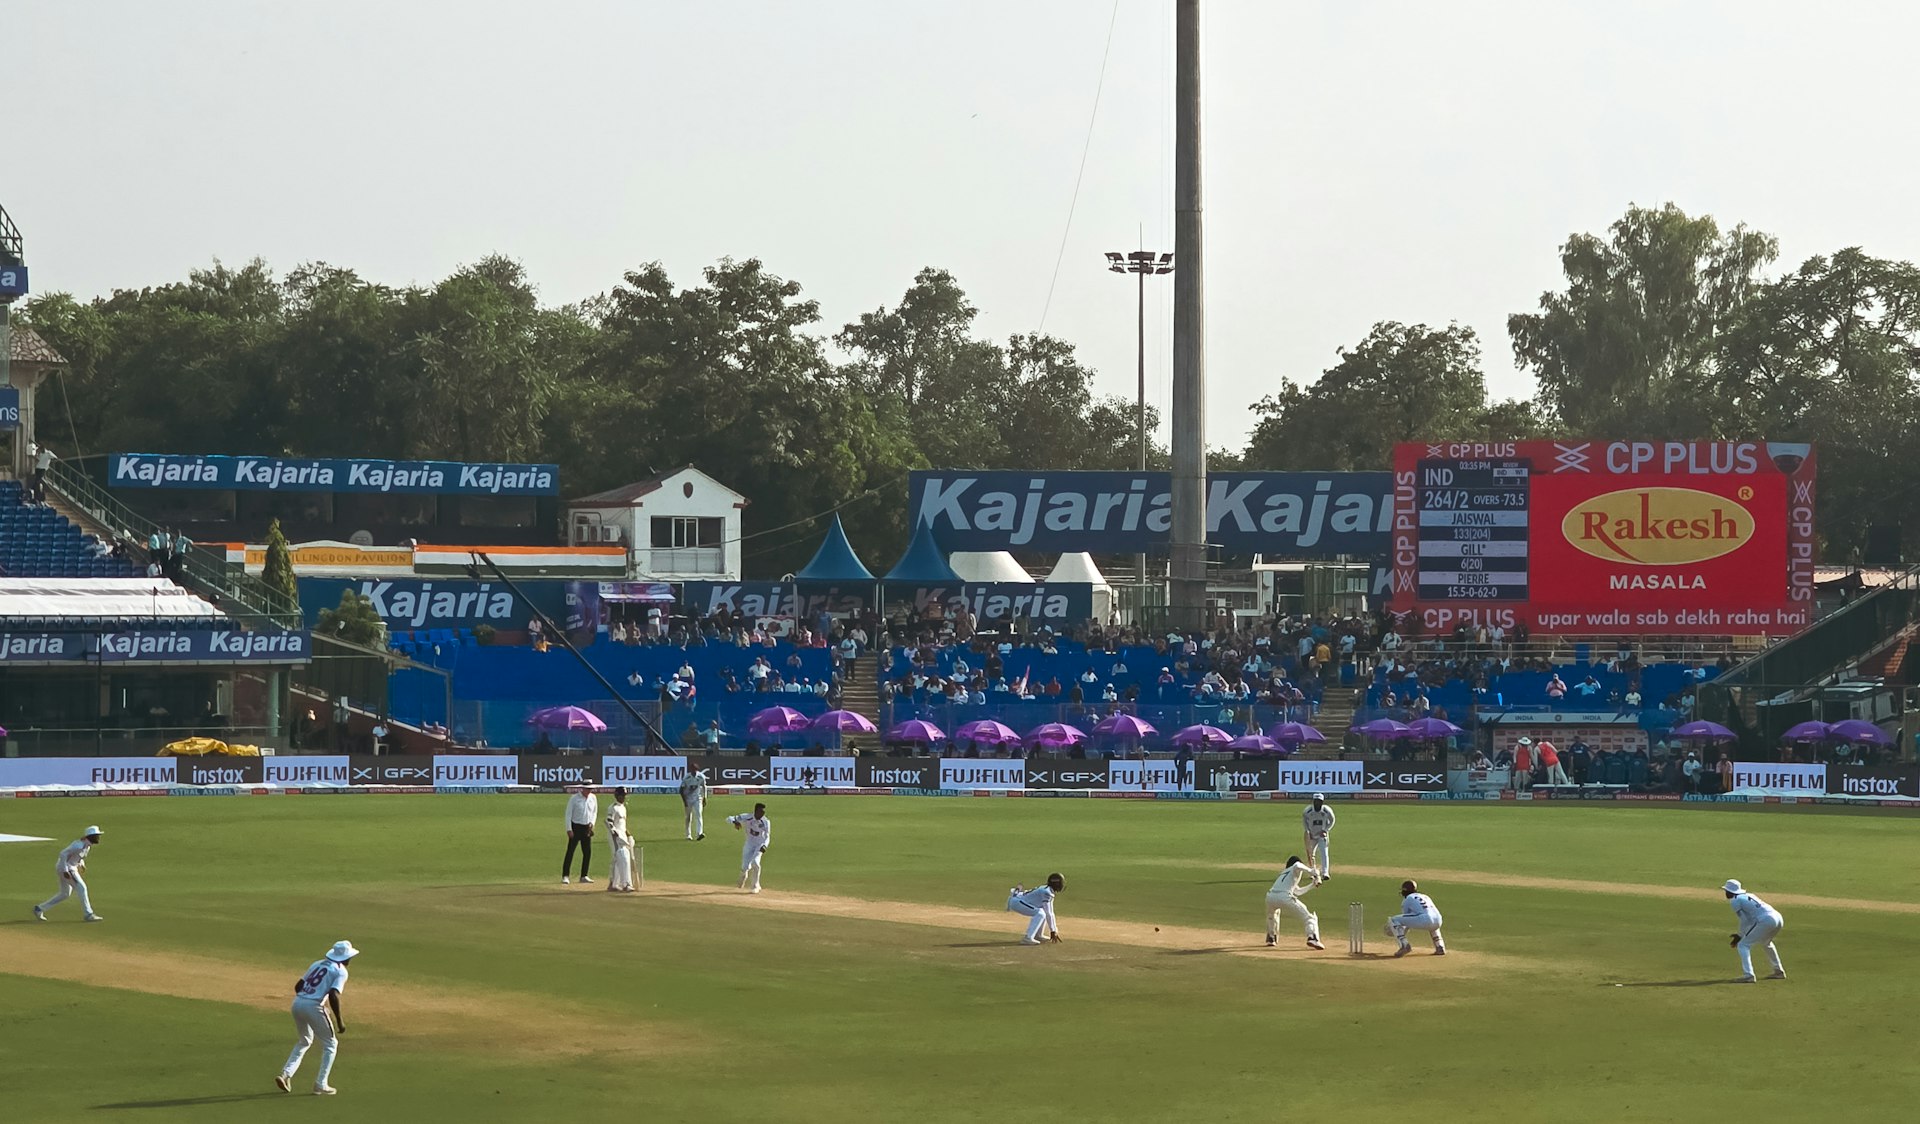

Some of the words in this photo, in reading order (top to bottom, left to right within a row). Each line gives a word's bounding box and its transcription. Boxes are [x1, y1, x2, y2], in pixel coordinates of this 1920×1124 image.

[1450, 444, 1470, 458] CP
[1474, 443, 1515, 458] PLUS
[1606, 442, 1654, 475] CP
[1665, 442, 1757, 475] PLUS
[116, 456, 218, 486] Kajaria
[235, 459, 334, 489] Kajaria
[1459, 461, 1477, 471] 03:35
[1478, 461, 1491, 471] PM
[348, 463, 444, 491] Kajaria
[458, 466, 552, 493] Kajaria
[1425, 468, 1454, 486] IND
[1396, 470, 1416, 530] PLUS
[1425, 490, 1469, 509] 264/2
[1473, 494, 1500, 505] OVERS
[916, 478, 1171, 546] Kajaria
[1452, 513, 1496, 526] JAISWAL
[1579, 493, 1740, 563] Rakesh
[1792, 506, 1811, 538] CP
[1453, 528, 1491, 541] 133(204)
[355, 553, 406, 563] PAVILION
[1396, 535, 1416, 566] CP
[1461, 558, 1483, 571] 6(20)
[1791, 542, 1811, 601] PLUS
[1457, 573, 1489, 584] PIERRE
[1610, 574, 1707, 590] MASALA
[1447, 586, 1498, 598] 15.5-0-62-0
[361, 581, 514, 627] Kajaria
[1423, 608, 1453, 629] CP
[1538, 612, 1581, 629] upar
[1586, 609, 1630, 626] wala
[1636, 609, 1669, 626] sab
[1674, 609, 1721, 626] dekh
[1726, 609, 1770, 626] raha
[1776, 609, 1806, 625] hai
[0, 633, 64, 660] jaria
[96, 631, 191, 658] Kajaria
[209, 630, 303, 657] Kajaria
[92, 767, 175, 783] FUJIFILM
[192, 766, 244, 784] instax
[265, 766, 347, 781] FUJIFILM
[384, 767, 430, 779] GFX
[435, 765, 516, 780] FUJIFILM
[533, 763, 584, 782] instax
[604, 766, 686, 781] FUJIFILM
[722, 768, 767, 780] GFX
[870, 765, 921, 784] instax
[942, 768, 1023, 784] FUJIFILM
[1060, 771, 1106, 783] GFX
[1281, 770, 1361, 786] FUJIFILM
[1398, 773, 1443, 785] GFX
[1736, 772, 1824, 789] FUJIFILM
[169, 788, 201, 796] ASTRAL
[203, 788, 234, 796] ASTRAL
[893, 788, 925, 796] ASTRAL
[1843, 774, 1899, 794] instax
[927, 789, 958, 797] ASTRAL
[1157, 791, 1187, 799] ASTRAL
[1453, 792, 1483, 800] ASTRAL
[1682, 794, 1713, 802] ASTRAL
[306, 966, 328, 988] 48
